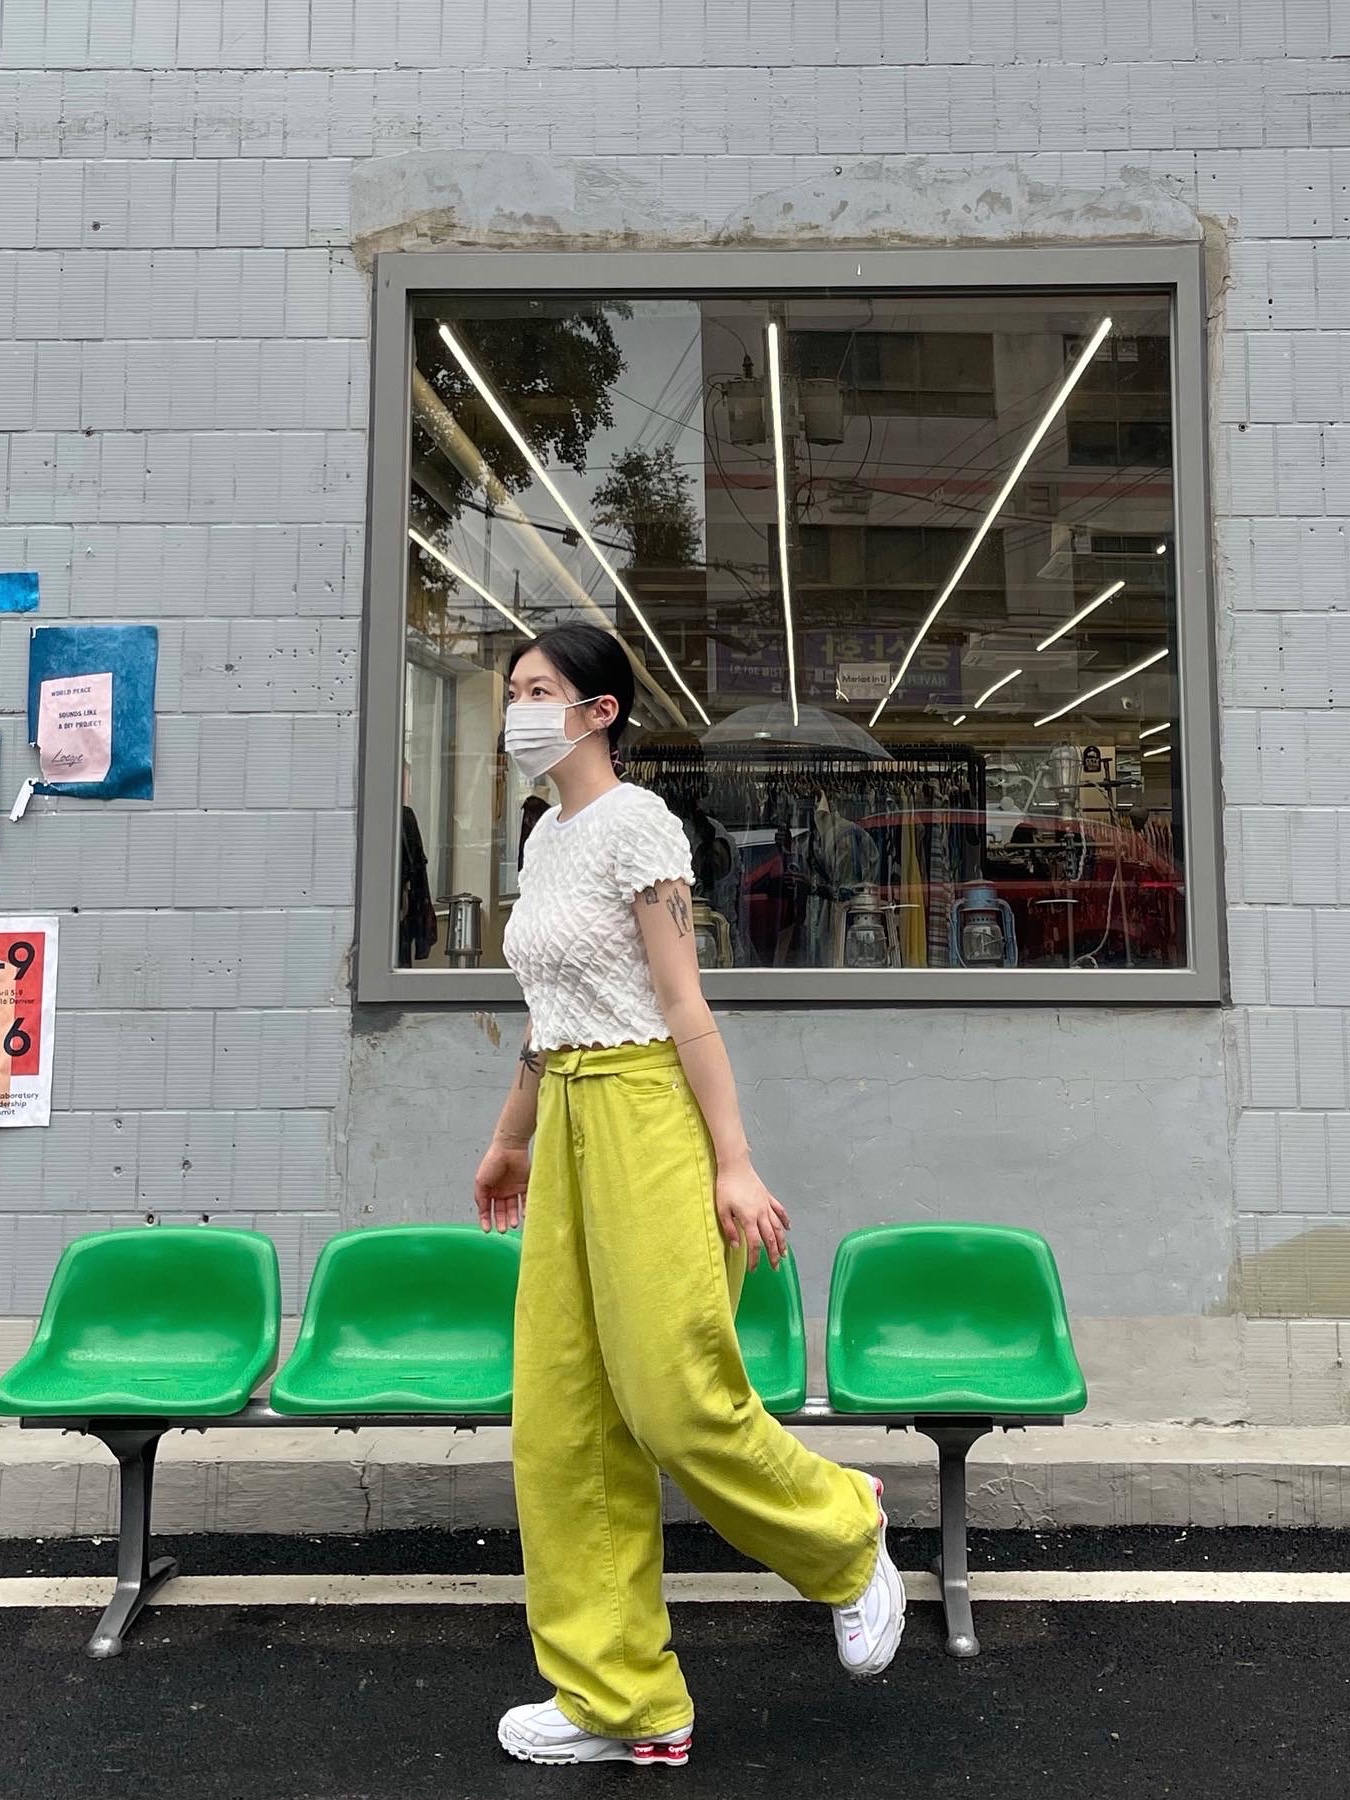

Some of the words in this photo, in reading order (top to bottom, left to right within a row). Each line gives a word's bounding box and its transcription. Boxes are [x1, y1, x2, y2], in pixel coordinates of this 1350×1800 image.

[51, 688, 72, 697] WORLD
[72, 686, 92, 695] PEACE
[58, 710, 82, 719] SOUNDS
[63, 722, 74, 730] DIY
[75, 720, 102, 729] PROJECT
[3, 1017, 31, 1057] 6
